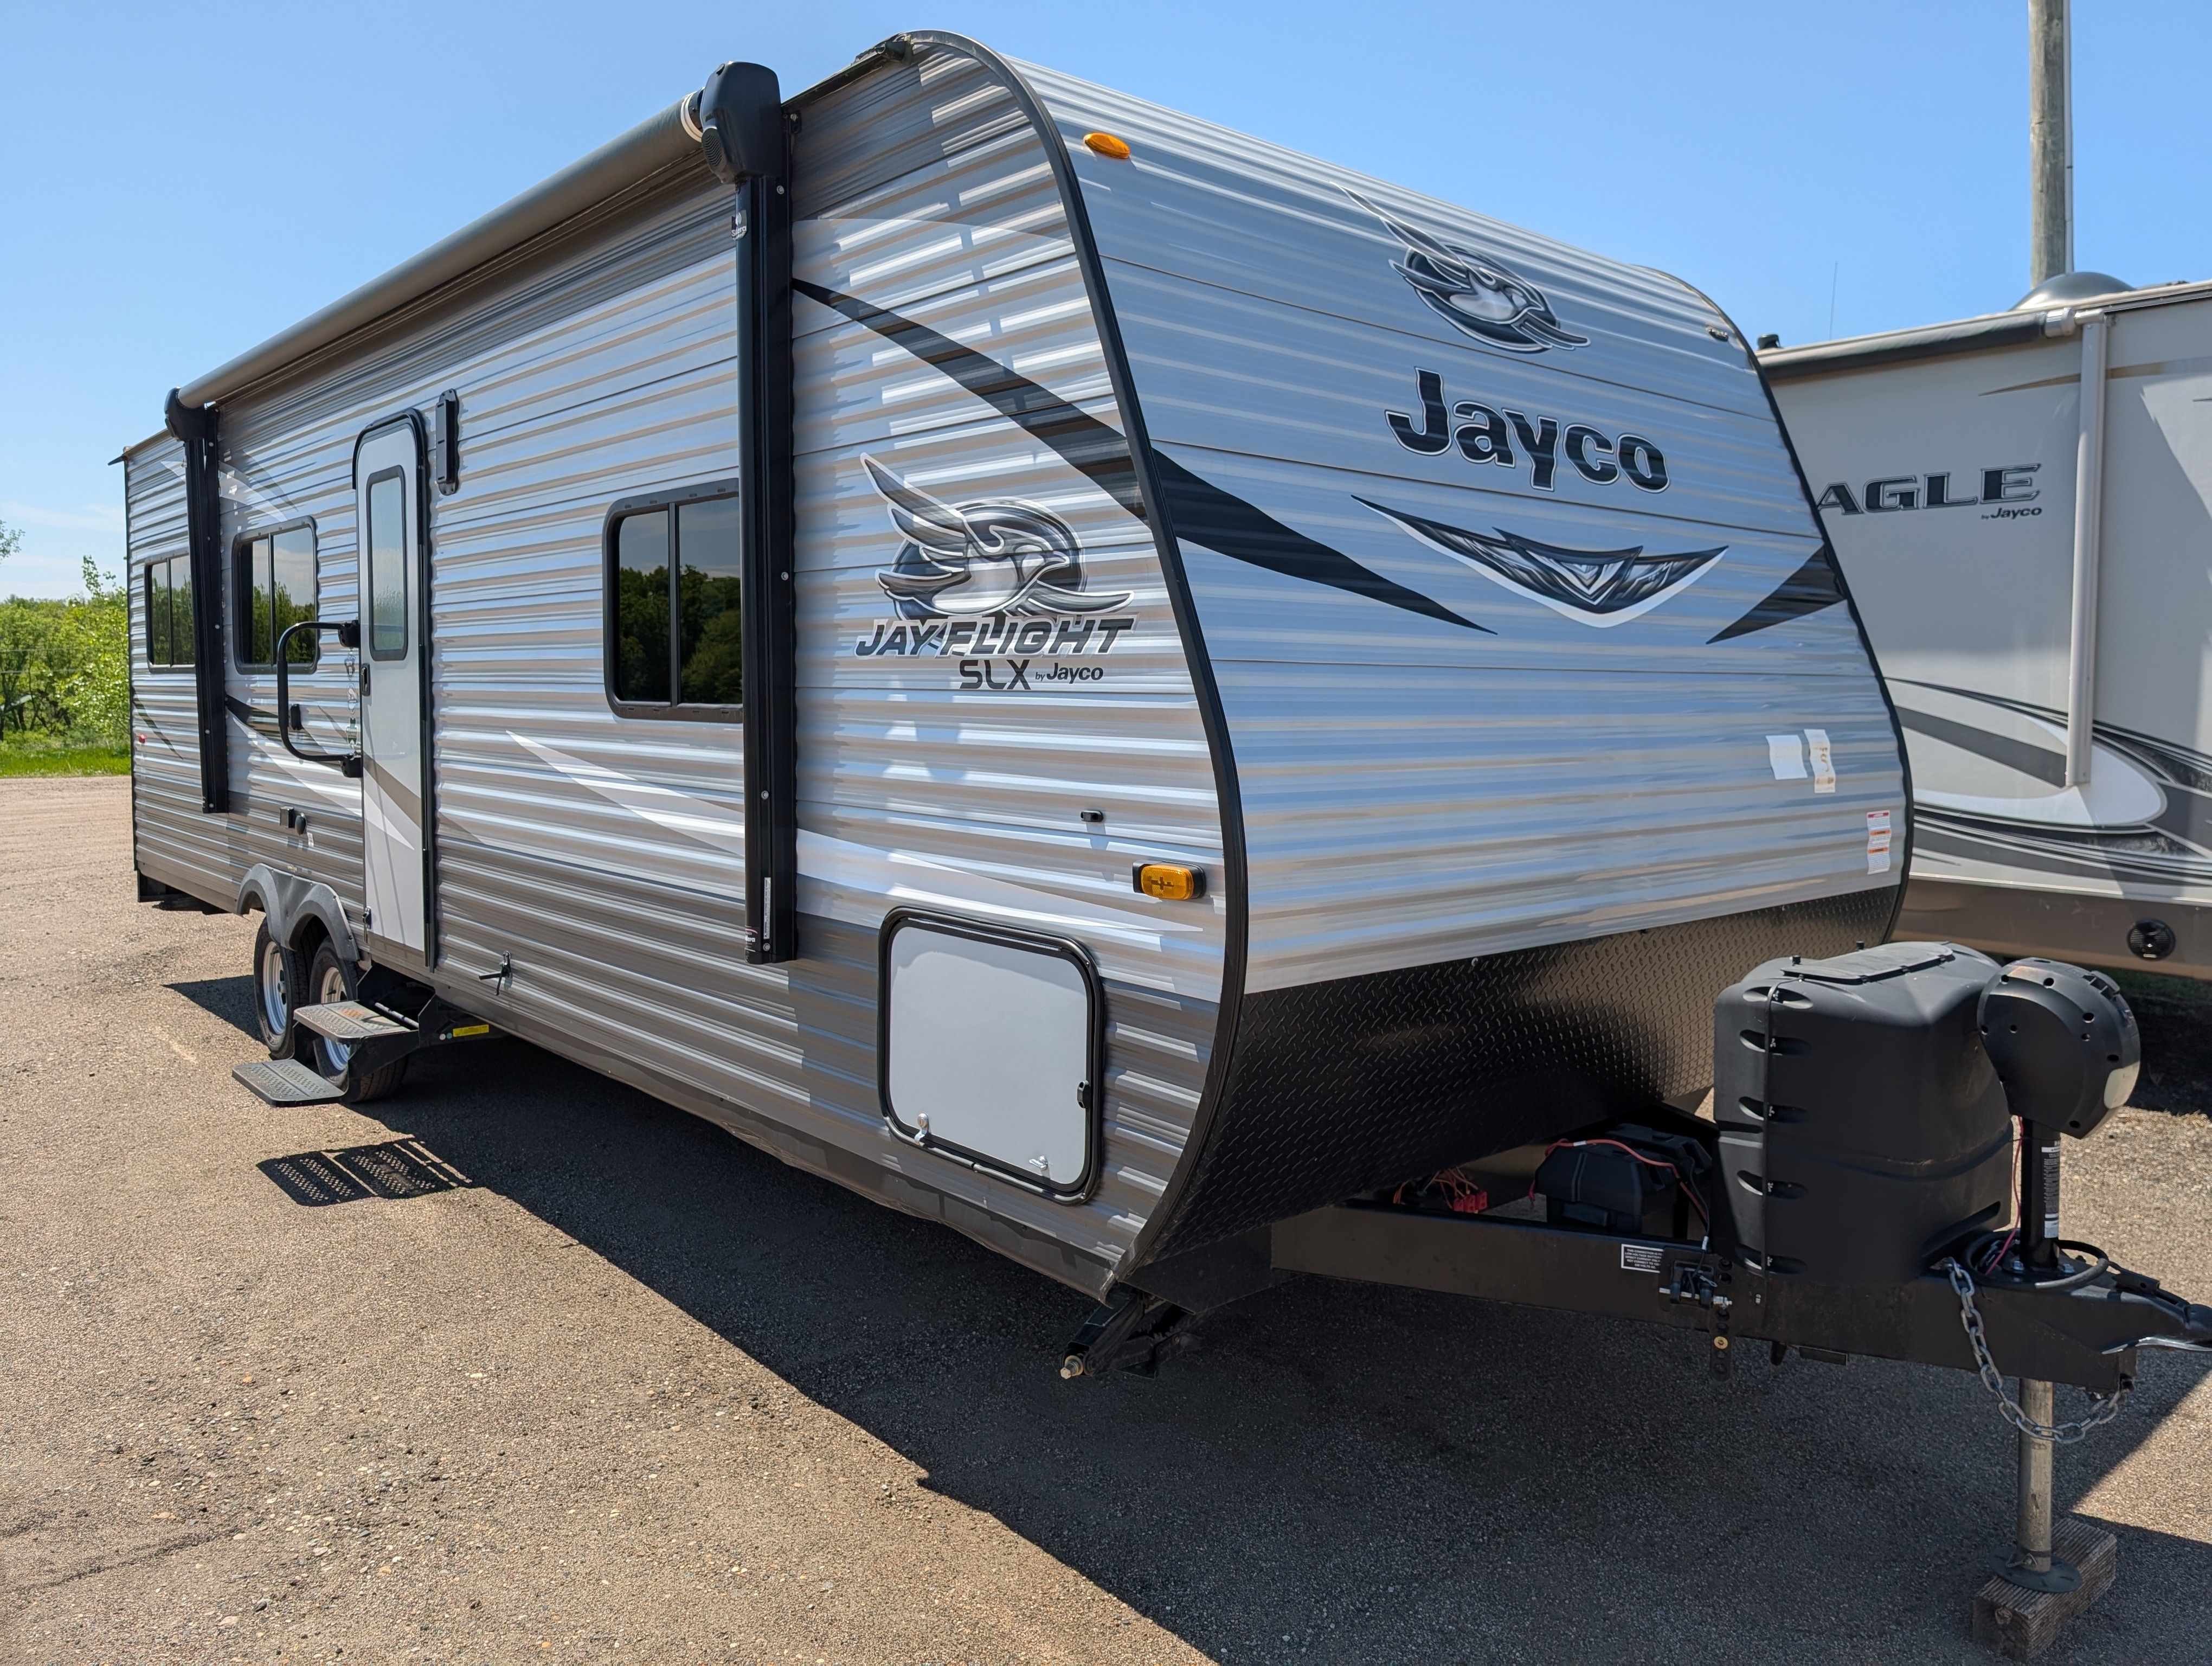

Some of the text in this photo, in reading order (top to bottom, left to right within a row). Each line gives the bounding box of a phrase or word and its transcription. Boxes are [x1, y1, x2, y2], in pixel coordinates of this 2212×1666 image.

[1384, 366, 1670, 493] Jayco
[1816, 463, 2041, 515] AGLE
[1990, 507, 2042, 520] Jayco
[856, 615, 1137, 658] JAY FLIGHT
[960, 659, 1104, 690] SLX by Jayco
